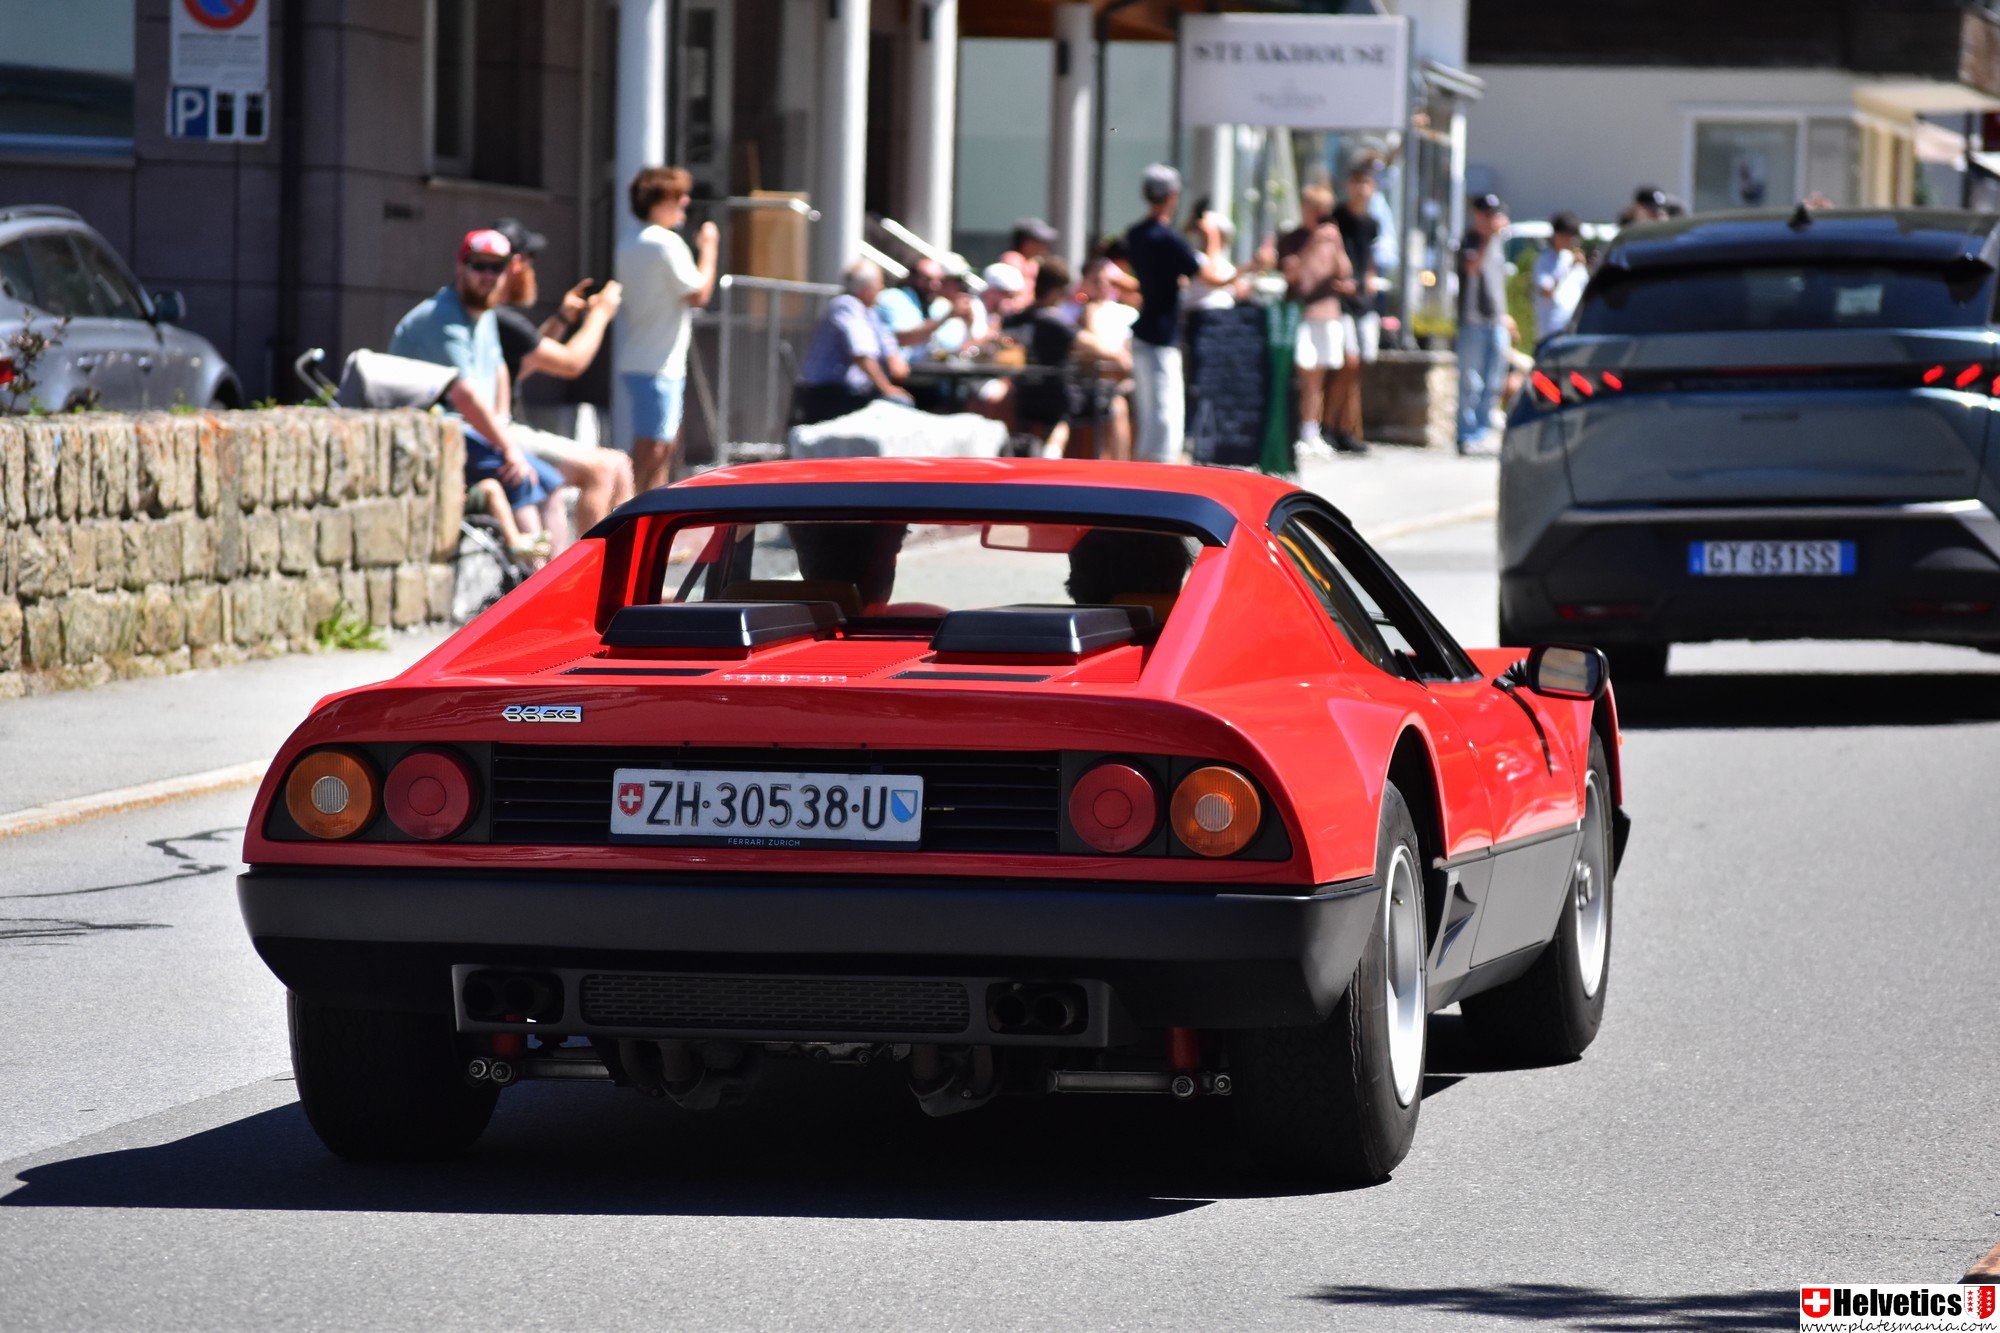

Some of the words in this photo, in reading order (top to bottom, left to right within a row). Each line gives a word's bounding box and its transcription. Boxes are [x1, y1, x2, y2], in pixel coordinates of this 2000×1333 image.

[177, 90, 205, 135] P
[728, 837, 765, 846] FERRARI
[768, 839, 801, 847] ZURICH
